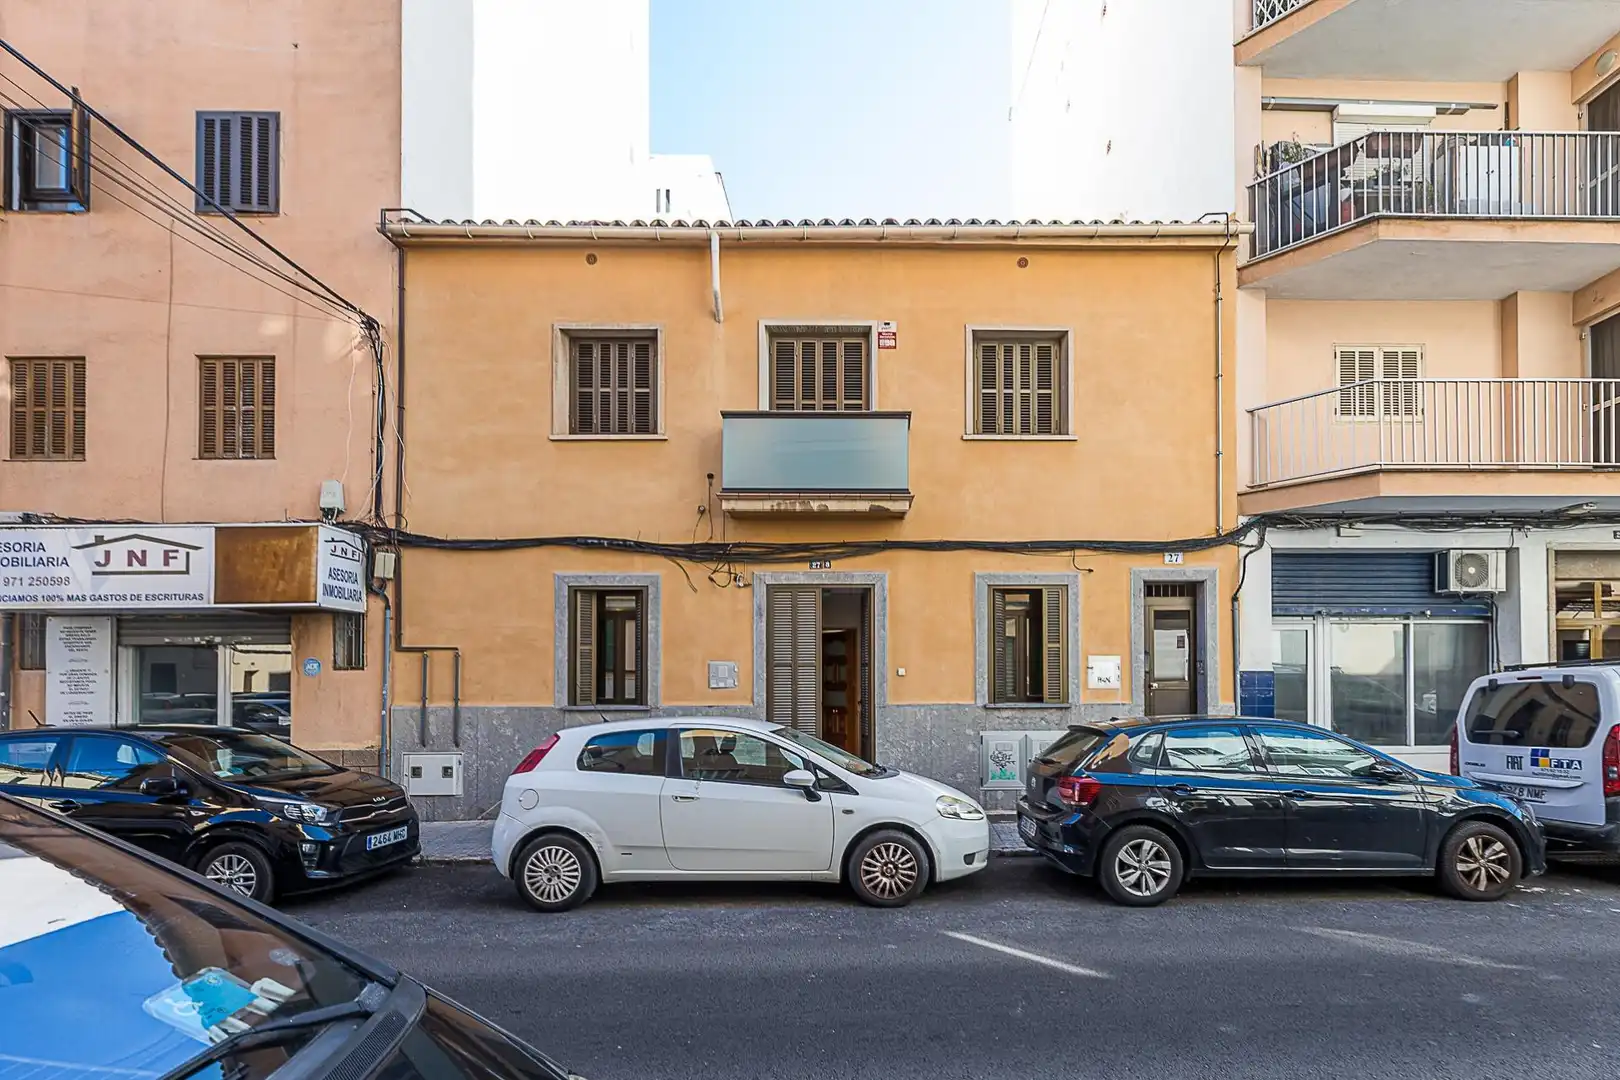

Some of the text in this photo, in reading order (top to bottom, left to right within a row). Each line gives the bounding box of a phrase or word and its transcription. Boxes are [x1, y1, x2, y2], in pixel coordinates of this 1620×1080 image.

[1168, 553, 1180, 563] 27
[3, 576, 71, 587] 971 250598
[328, 566, 359, 586] ASESORIA
[0, 593, 204, 603] CIAMOS 100% MAS GASTOS DE ESCRITURAS
[322, 583, 363, 602] INMOBILIARIA
[1506, 755, 1524, 770] FIAT
[1551, 759, 1581, 770] FTA
[373, 832, 392, 846] 2464
